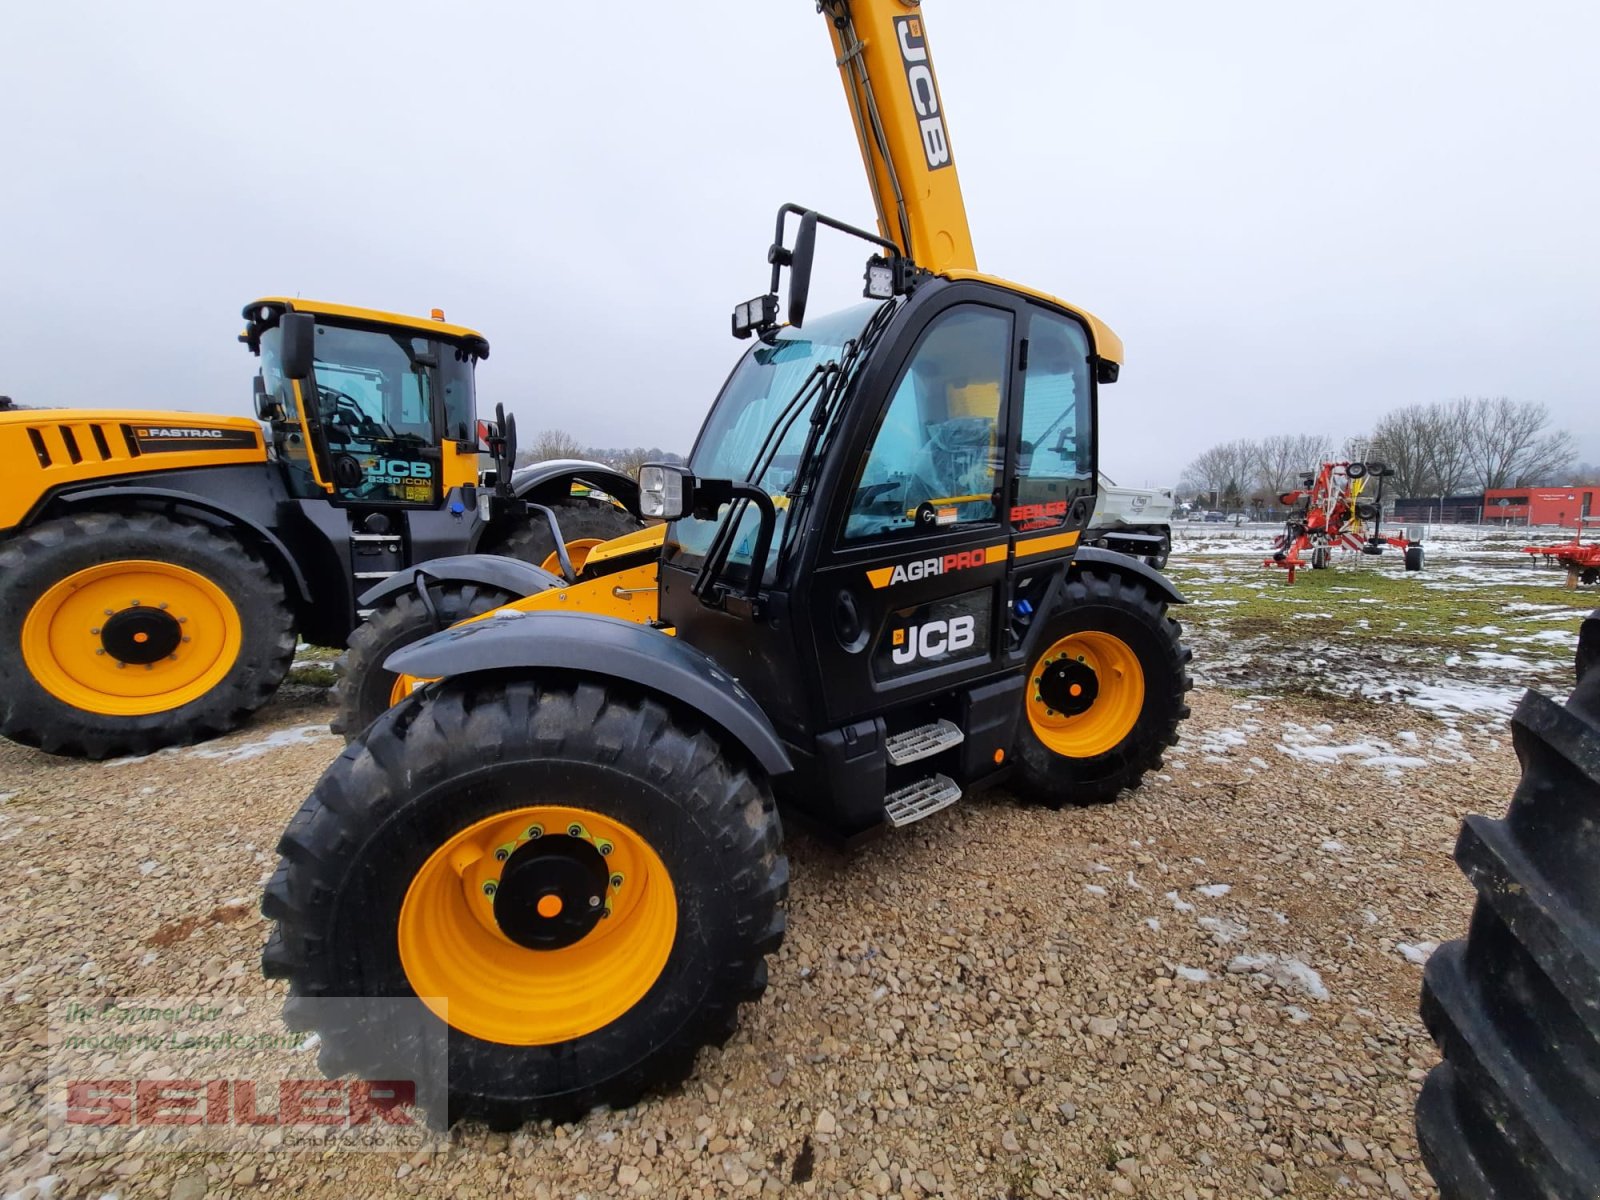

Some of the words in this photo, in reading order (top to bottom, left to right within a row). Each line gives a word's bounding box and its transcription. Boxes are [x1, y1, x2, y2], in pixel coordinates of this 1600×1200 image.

[897, 19, 949, 167] JCB
[149, 428, 223, 438] FASTRAC
[367, 459, 432, 478] JCB
[890, 548, 986, 585] AGRIPRO
[892, 615, 975, 665] JCB
